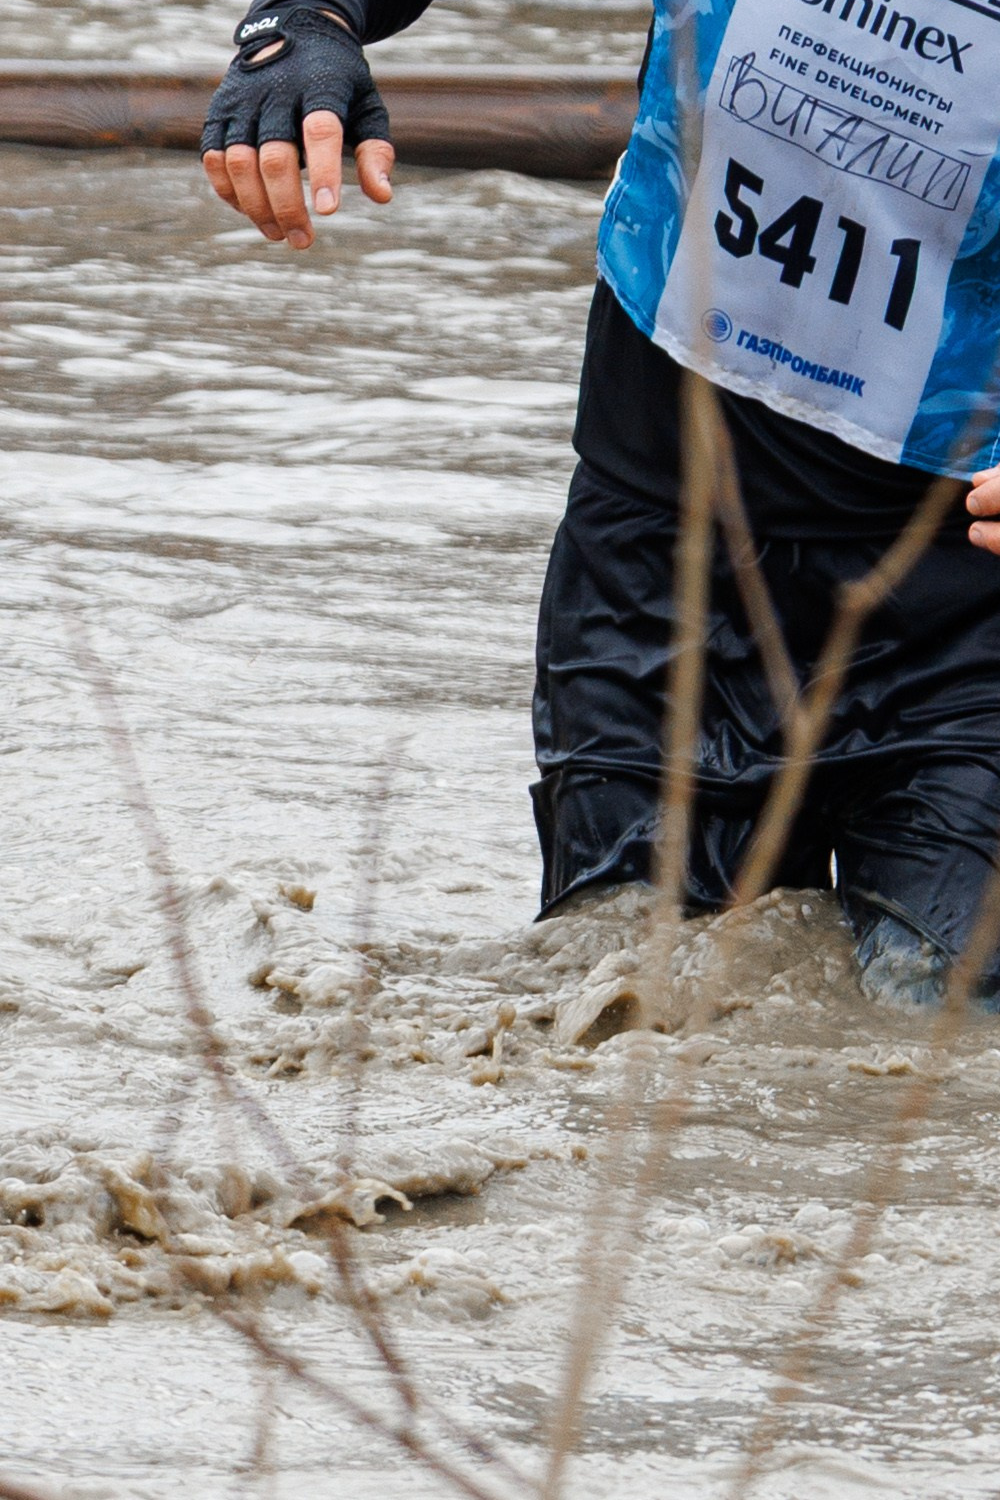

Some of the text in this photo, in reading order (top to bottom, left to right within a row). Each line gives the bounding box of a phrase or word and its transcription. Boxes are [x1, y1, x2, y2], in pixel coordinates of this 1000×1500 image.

[769, 48, 944, 135] FINE DEVELOPMENT
[777, 25, 953, 114] ПЕРФЕКЦИОНИСТЫ
[714, 157, 921, 331] 5411
[737, 330, 866, 397] ГАЗПРОМБАНК
